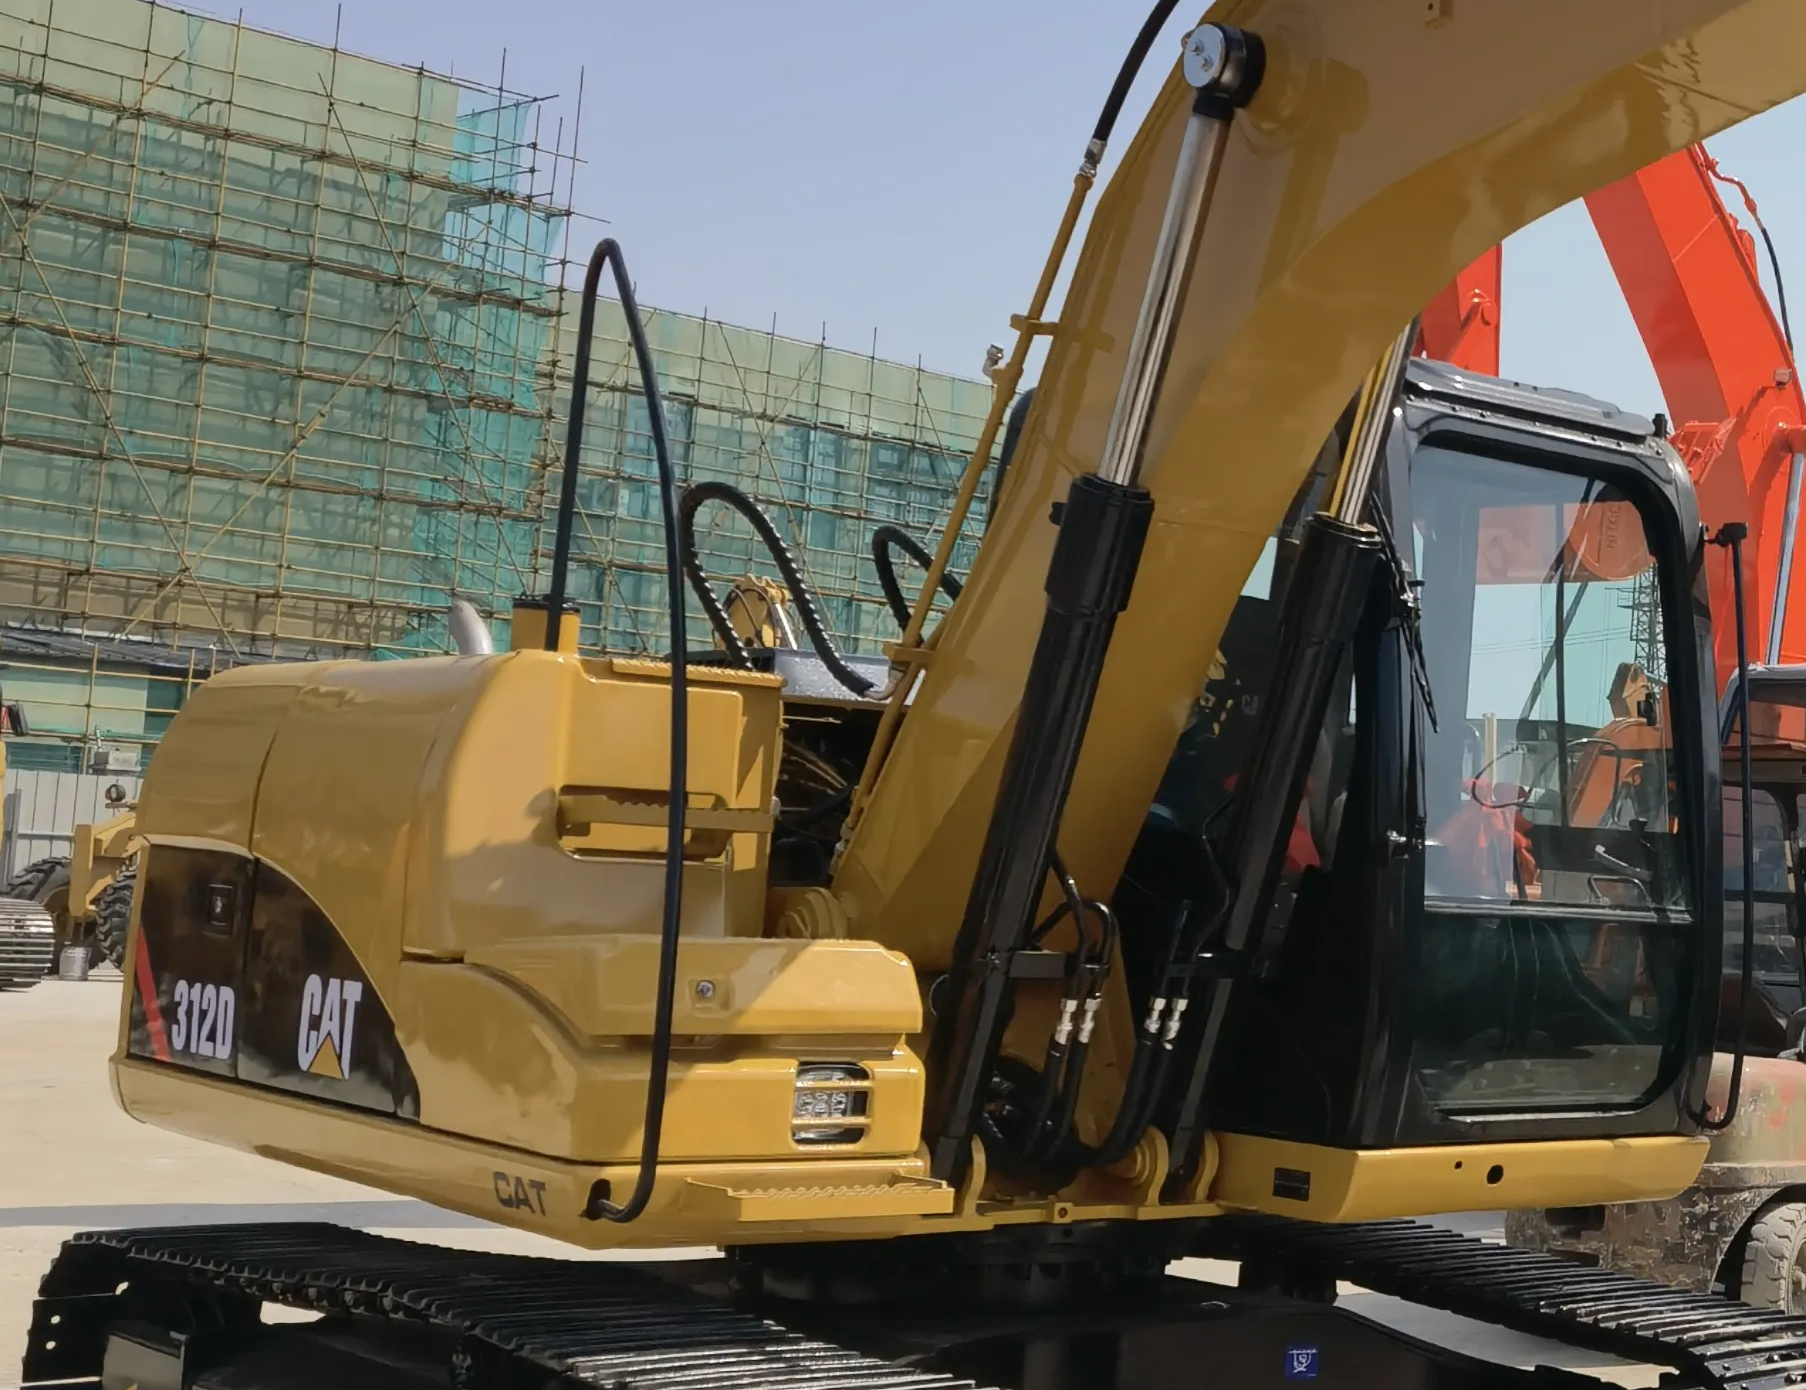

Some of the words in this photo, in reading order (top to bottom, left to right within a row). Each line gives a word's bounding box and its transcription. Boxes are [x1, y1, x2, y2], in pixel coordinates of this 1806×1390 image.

[171, 979, 235, 1061] 312D
[298, 973, 363, 1080] CAT
[493, 1171, 546, 1217] CAT
